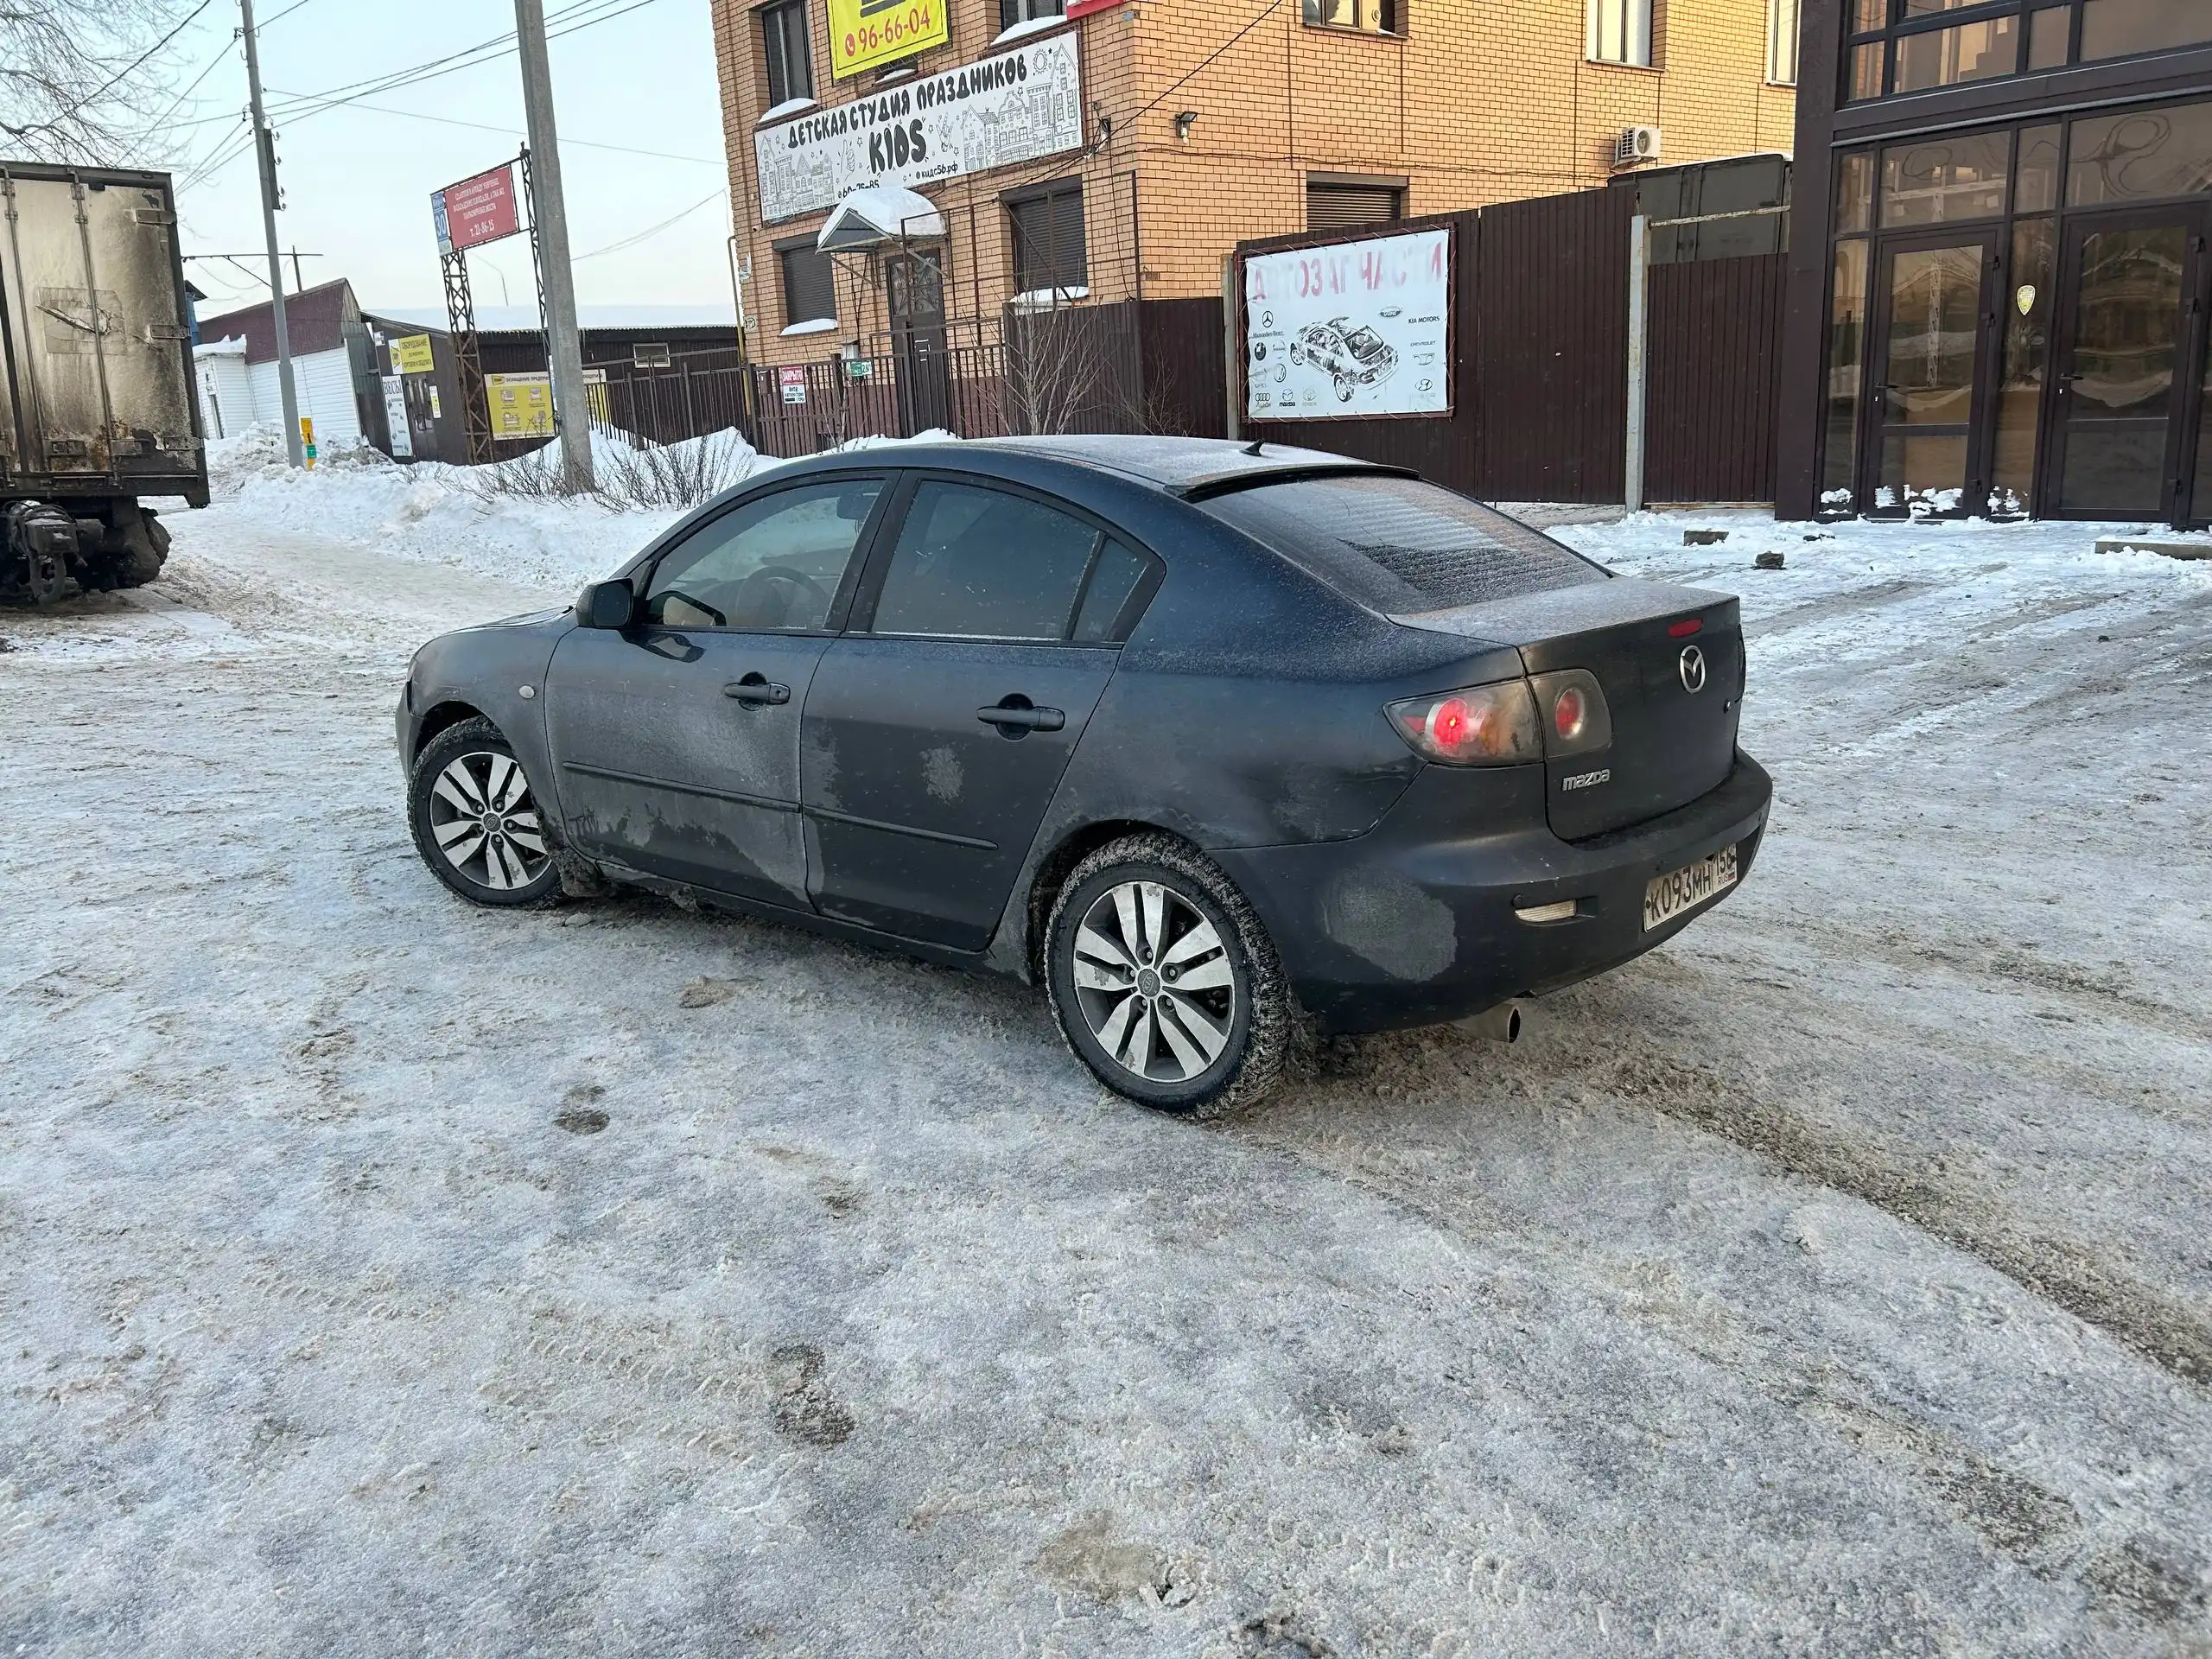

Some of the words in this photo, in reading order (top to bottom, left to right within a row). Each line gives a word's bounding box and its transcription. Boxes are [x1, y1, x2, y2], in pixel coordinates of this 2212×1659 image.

[858, 4, 931, 52] 96-66-04
[788, 111, 848, 149] ДЕТСКАЯ
[849, 89, 911, 133] СТУДИЯ
[916, 54, 1027, 111] ПРАЗДНИКОВ
[868, 118, 927, 174] KIDS
[435, 213, 446, 236] 30
[383, 379, 402, 395] ВЕСЫ
[1561, 768, 1611, 791] mazda
